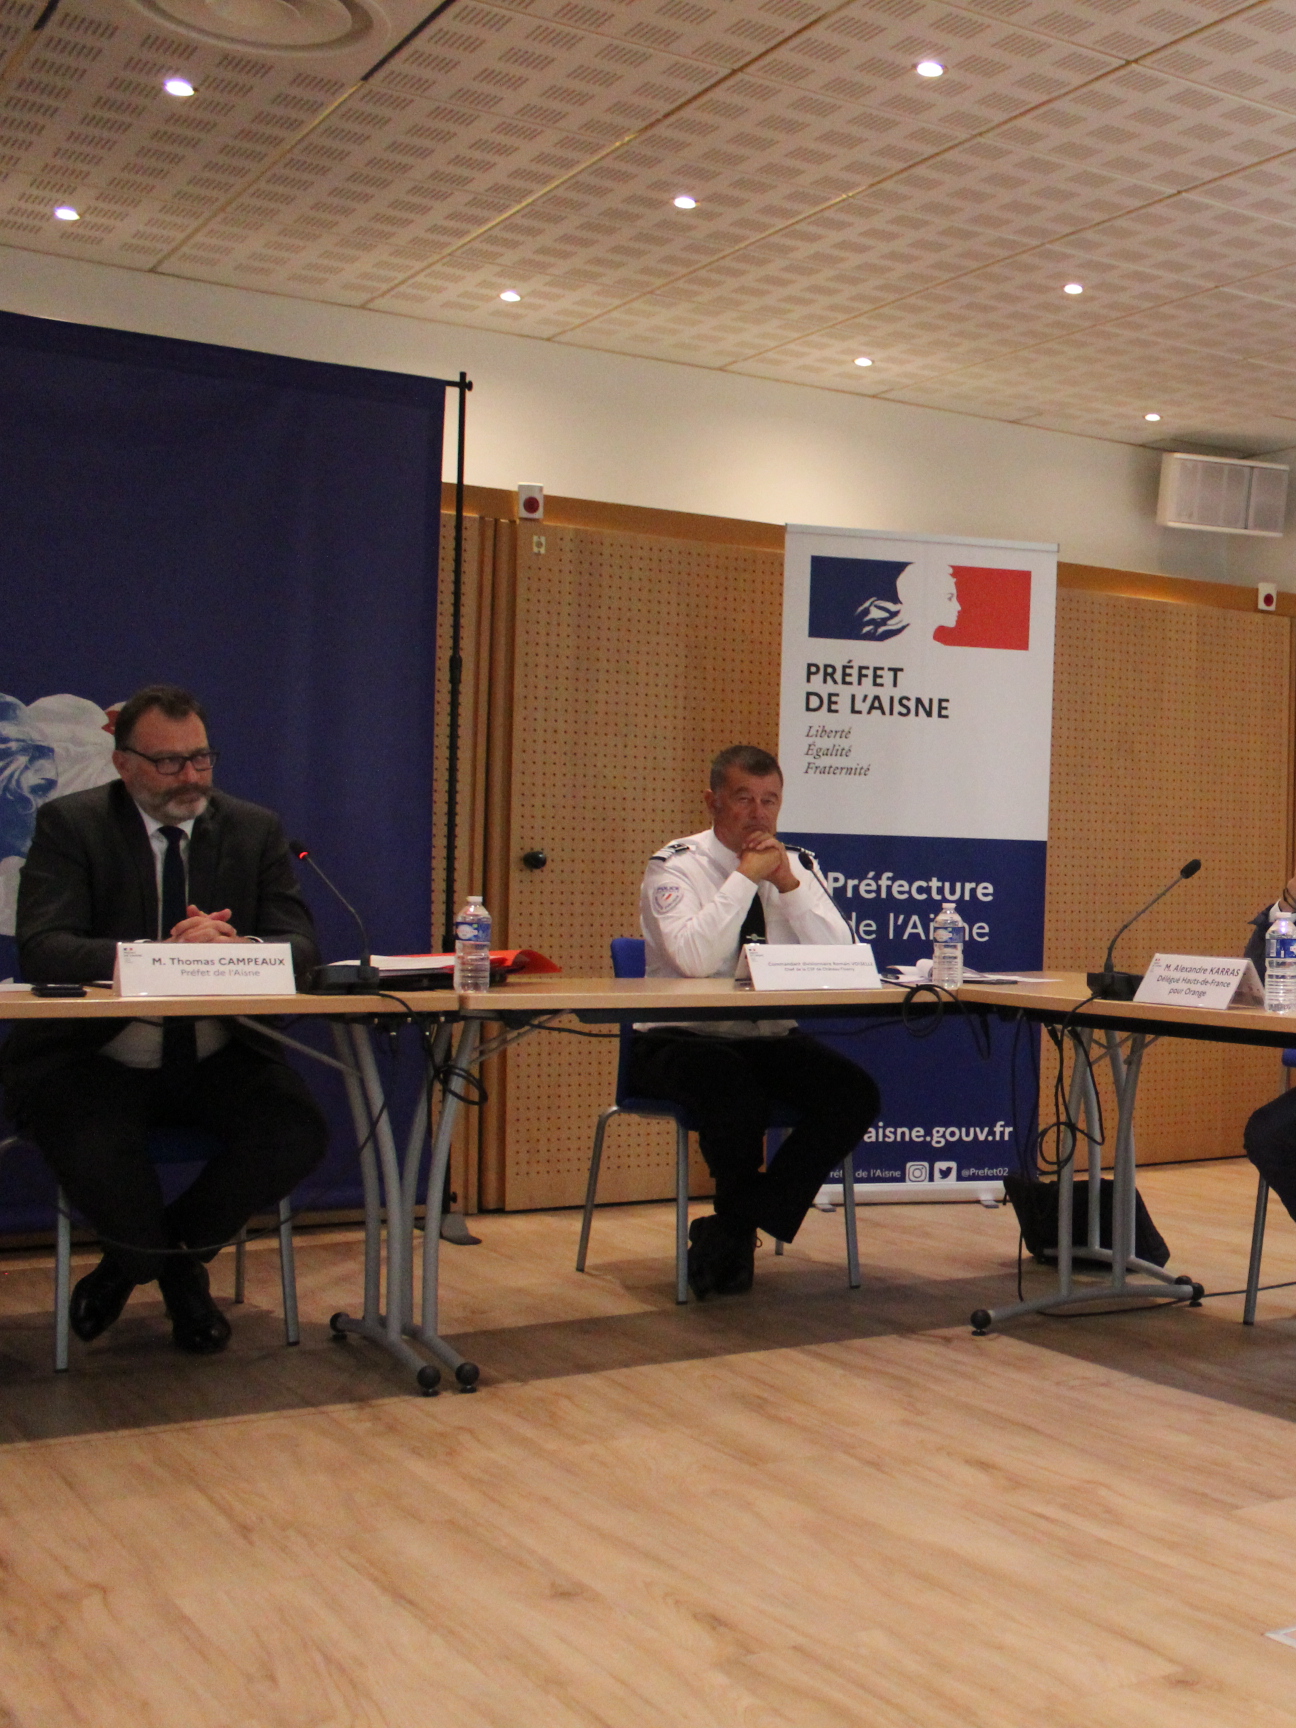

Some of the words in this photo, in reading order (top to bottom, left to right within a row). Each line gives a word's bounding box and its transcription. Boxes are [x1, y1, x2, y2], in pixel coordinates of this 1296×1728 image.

[806, 659, 904, 688] PRÉFET
[805, 691, 840, 713] DE
[850, 693, 950, 719] L'AISNE
[805, 725, 852, 739] Liberté
[804, 741, 852, 760] Égalité
[803, 762, 871, 776] Fraternité
[827, 871, 994, 902] Préfecture
[152, 957, 166, 966] M.
[169, 957, 216, 966] Thomas
[218, 957, 286, 966] CAMPEAUX
[180, 968, 211, 977] Préfet
[214, 968, 226, 977] de
[229, 968, 261, 977] l'Aisne
[1163, 963, 1171, 971] M.
[1172, 964, 1207, 975] Alexandre
[1208, 966, 1241, 977] KARRAS
[1156, 975, 1181, 985] Délégué
[1181, 976, 1231, 988] Hauts-de-France
[1168, 988, 1183, 996] pour
[1184, 987, 1207, 999] Orange
[855, 1168, 868, 1178] de
[870, 1168, 901, 1178] l'Aisne
[961, 1167, 1009, 1178] @Prefet02
